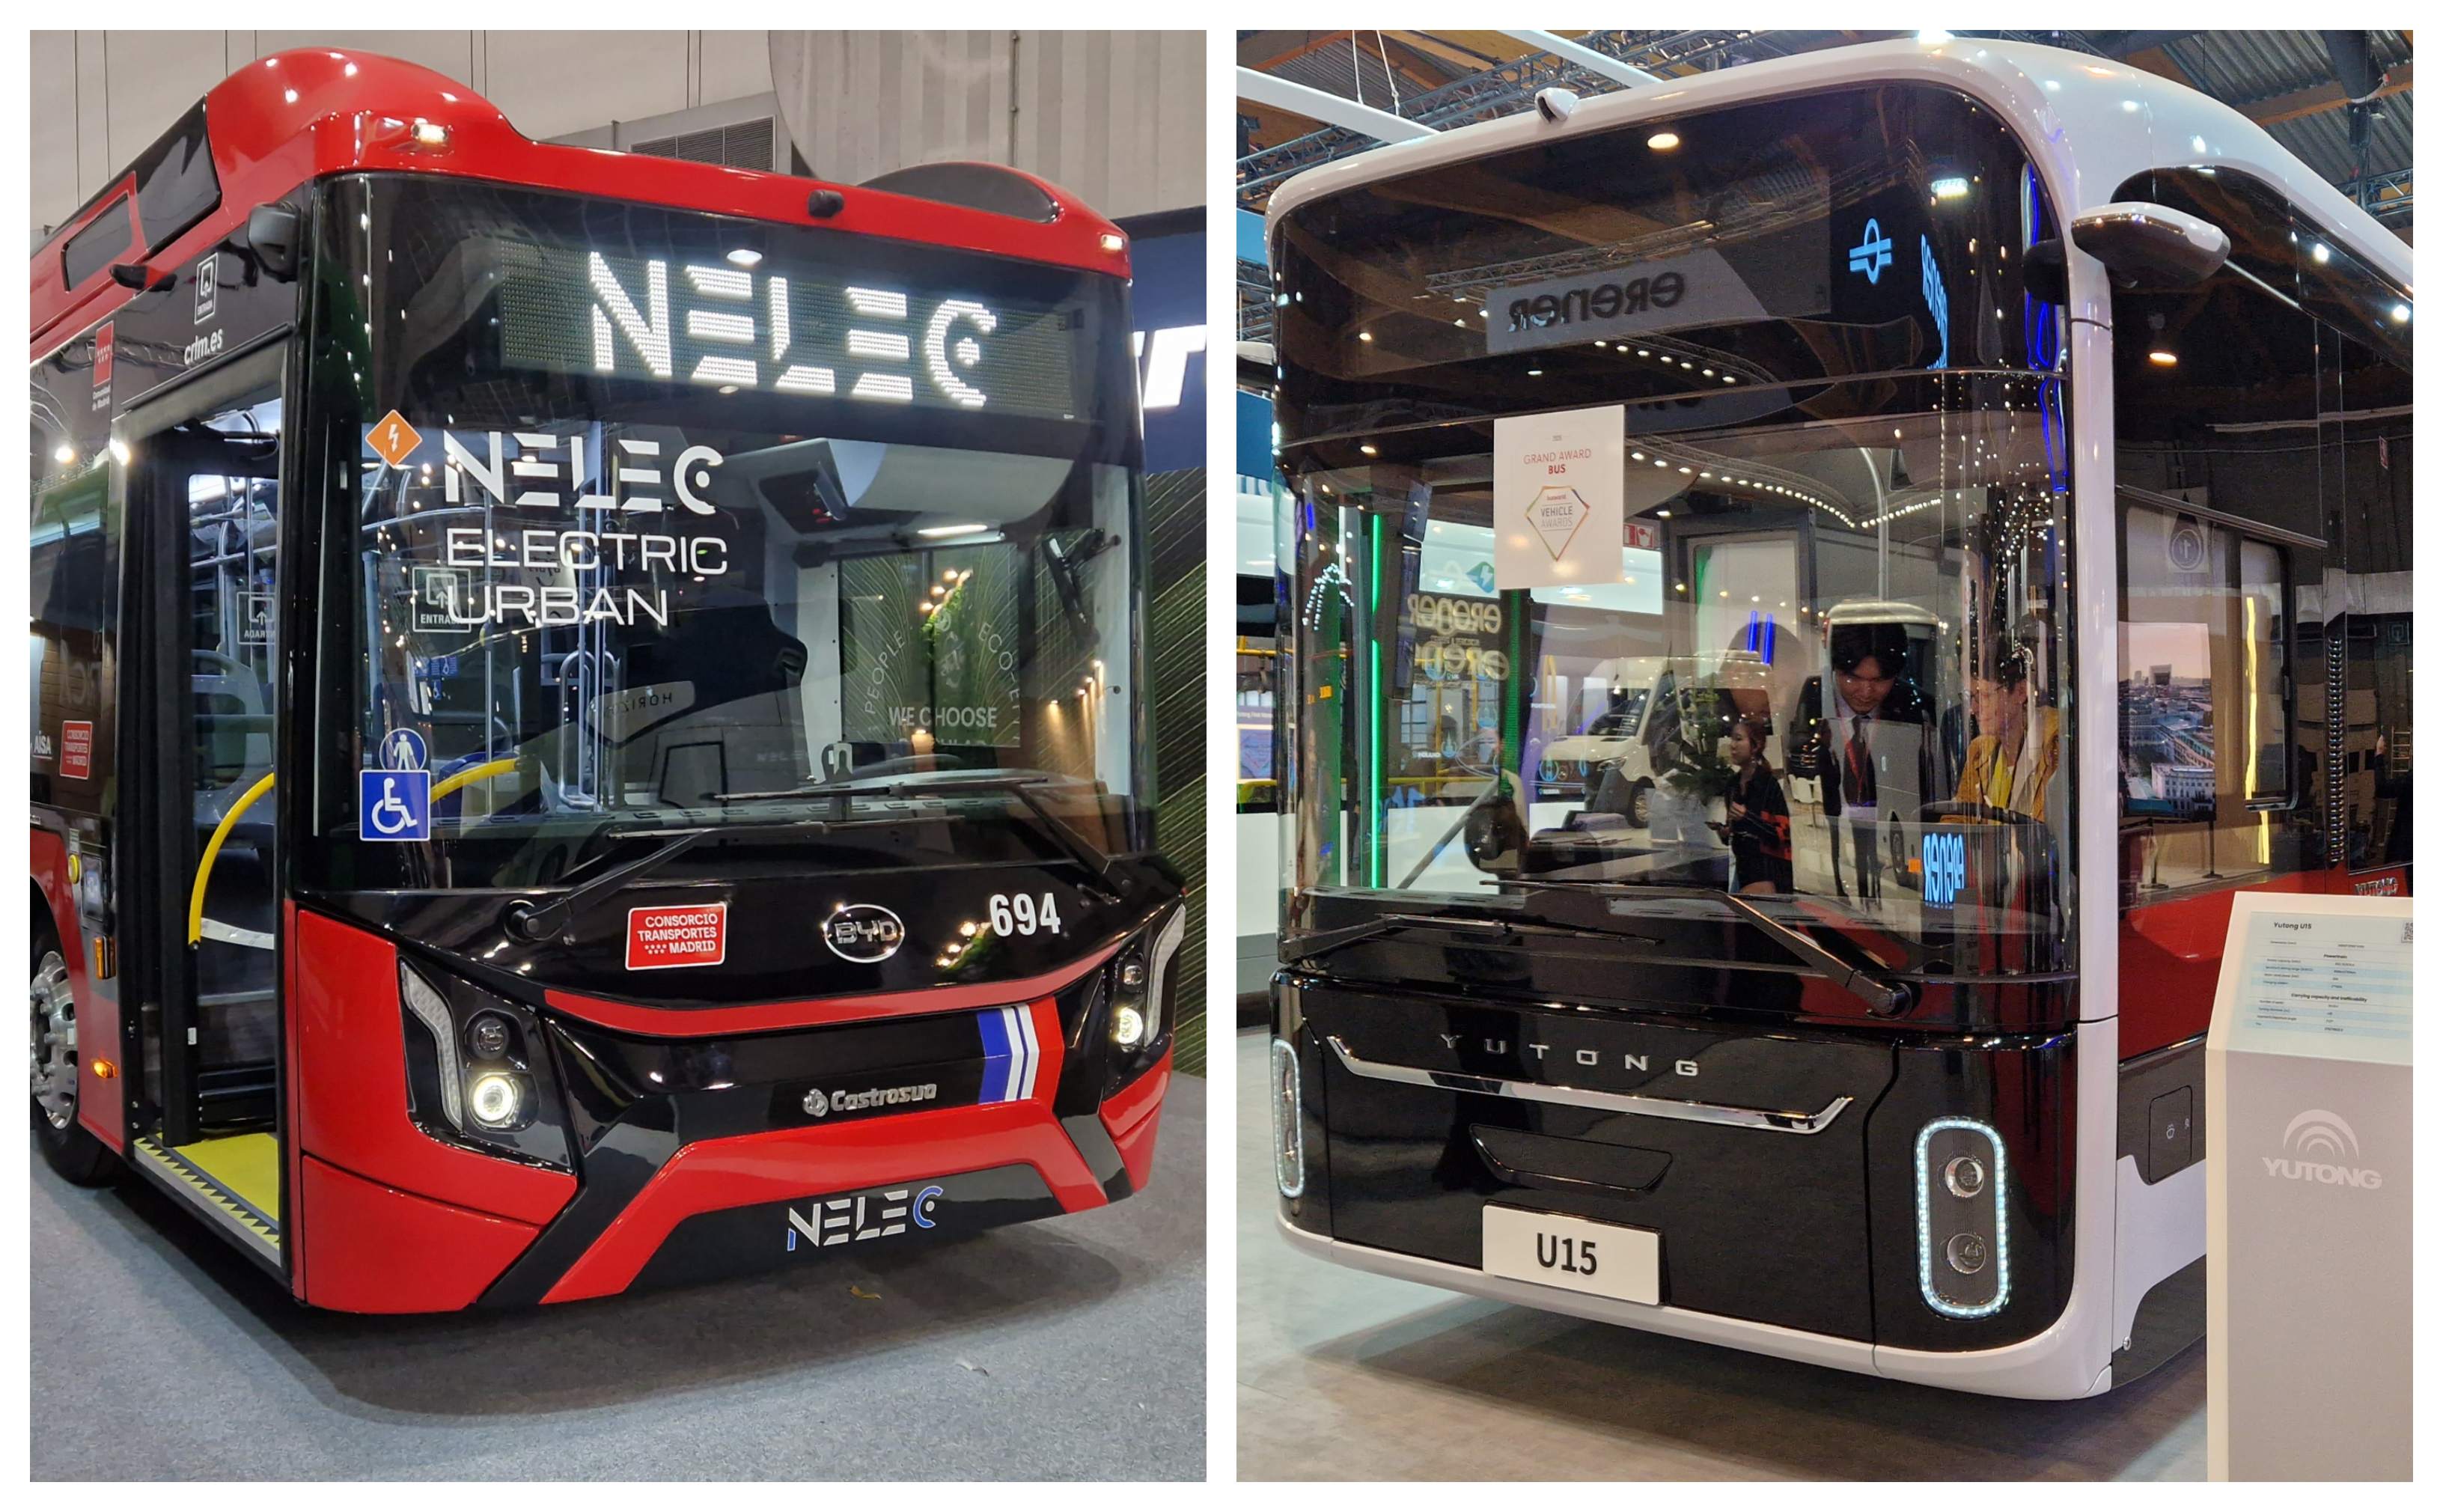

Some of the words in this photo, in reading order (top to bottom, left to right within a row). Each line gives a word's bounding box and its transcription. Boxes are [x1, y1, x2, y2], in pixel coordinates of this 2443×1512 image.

[588, 251, 998, 408] NELEC
[1523, 452, 1556, 465] GRAND
[1559, 448, 1591, 460] AWARD
[1548, 463, 1566, 475] BUS
[443, 430, 725, 516] NELEC
[1540, 506, 1573, 517] VEHICLE
[1541, 517, 1573, 528] AWARDS
[447, 528, 728, 575] ELECTRIC
[447, 585, 668, 627] URBAN
[420, 614, 464, 625] ENTRA
[864, 630, 906, 715] PEOPLE
[888, 707, 915, 727] WE
[645, 913, 719, 928] CONSORCIO
[989, 893, 1061, 937] 694
[2273, 921, 2299, 930] Yutong
[637, 927, 717, 942] TRANSPORTES
[835, 920, 897, 945] BYD
[668, 940, 716, 954] MADRID
[1441, 1033, 1700, 1076] YUTONG
[831, 1084, 937, 1112] Castrosua
[2262, 1156, 2382, 1190] YUTONG
[787, 1186, 944, 1252] NELEC
[1537, 1232, 1597, 1275] U15
